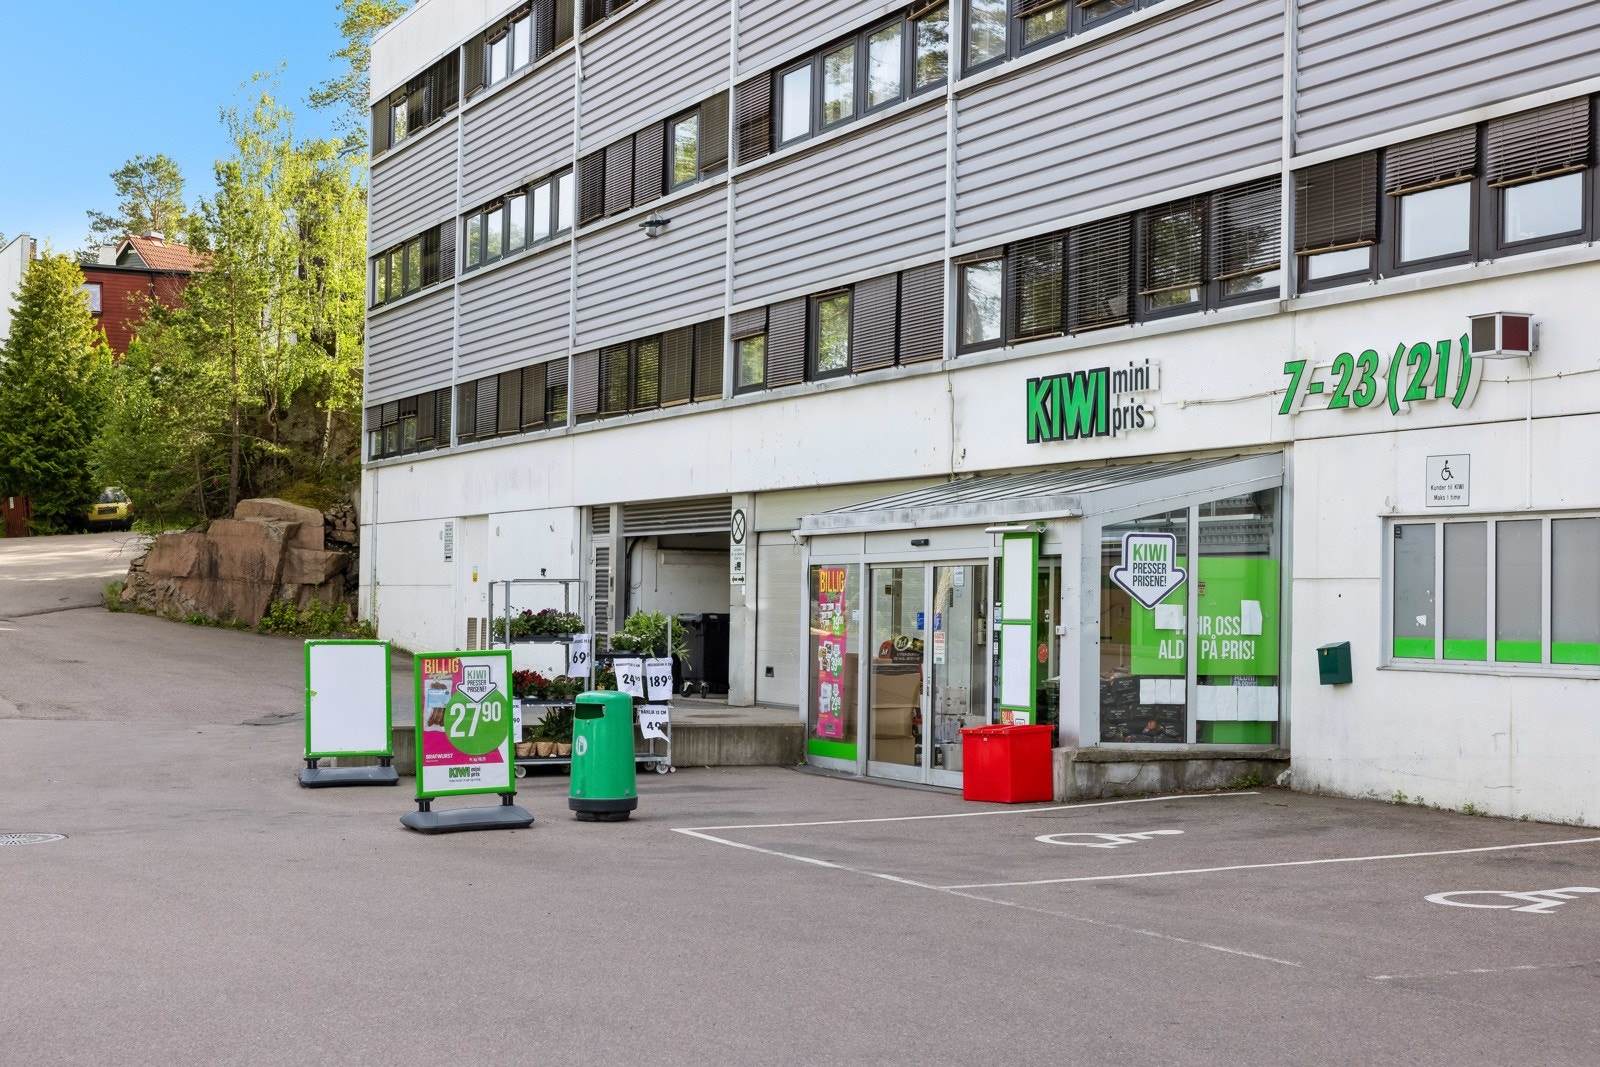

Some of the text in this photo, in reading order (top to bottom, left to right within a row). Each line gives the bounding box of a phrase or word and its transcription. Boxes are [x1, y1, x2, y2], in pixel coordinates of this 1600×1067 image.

[1026, 358, 1150, 444] KIWI mini
[1112, 397, 1145, 437] pris
[1133, 544, 1167, 561] KIWI
[1132, 562, 1167, 574] PRESSER
[820, 570, 845, 592] BILLIG
[1132, 575, 1167, 587] PRISENE!
[1215, 616, 1240, 635] OSS
[1158, 634, 1255, 660] ALD PÅ PRIS!
[424, 658, 459, 674] BILLIG
[466, 669, 487, 679] KIWI
[448, 766, 471, 778] KIWI
